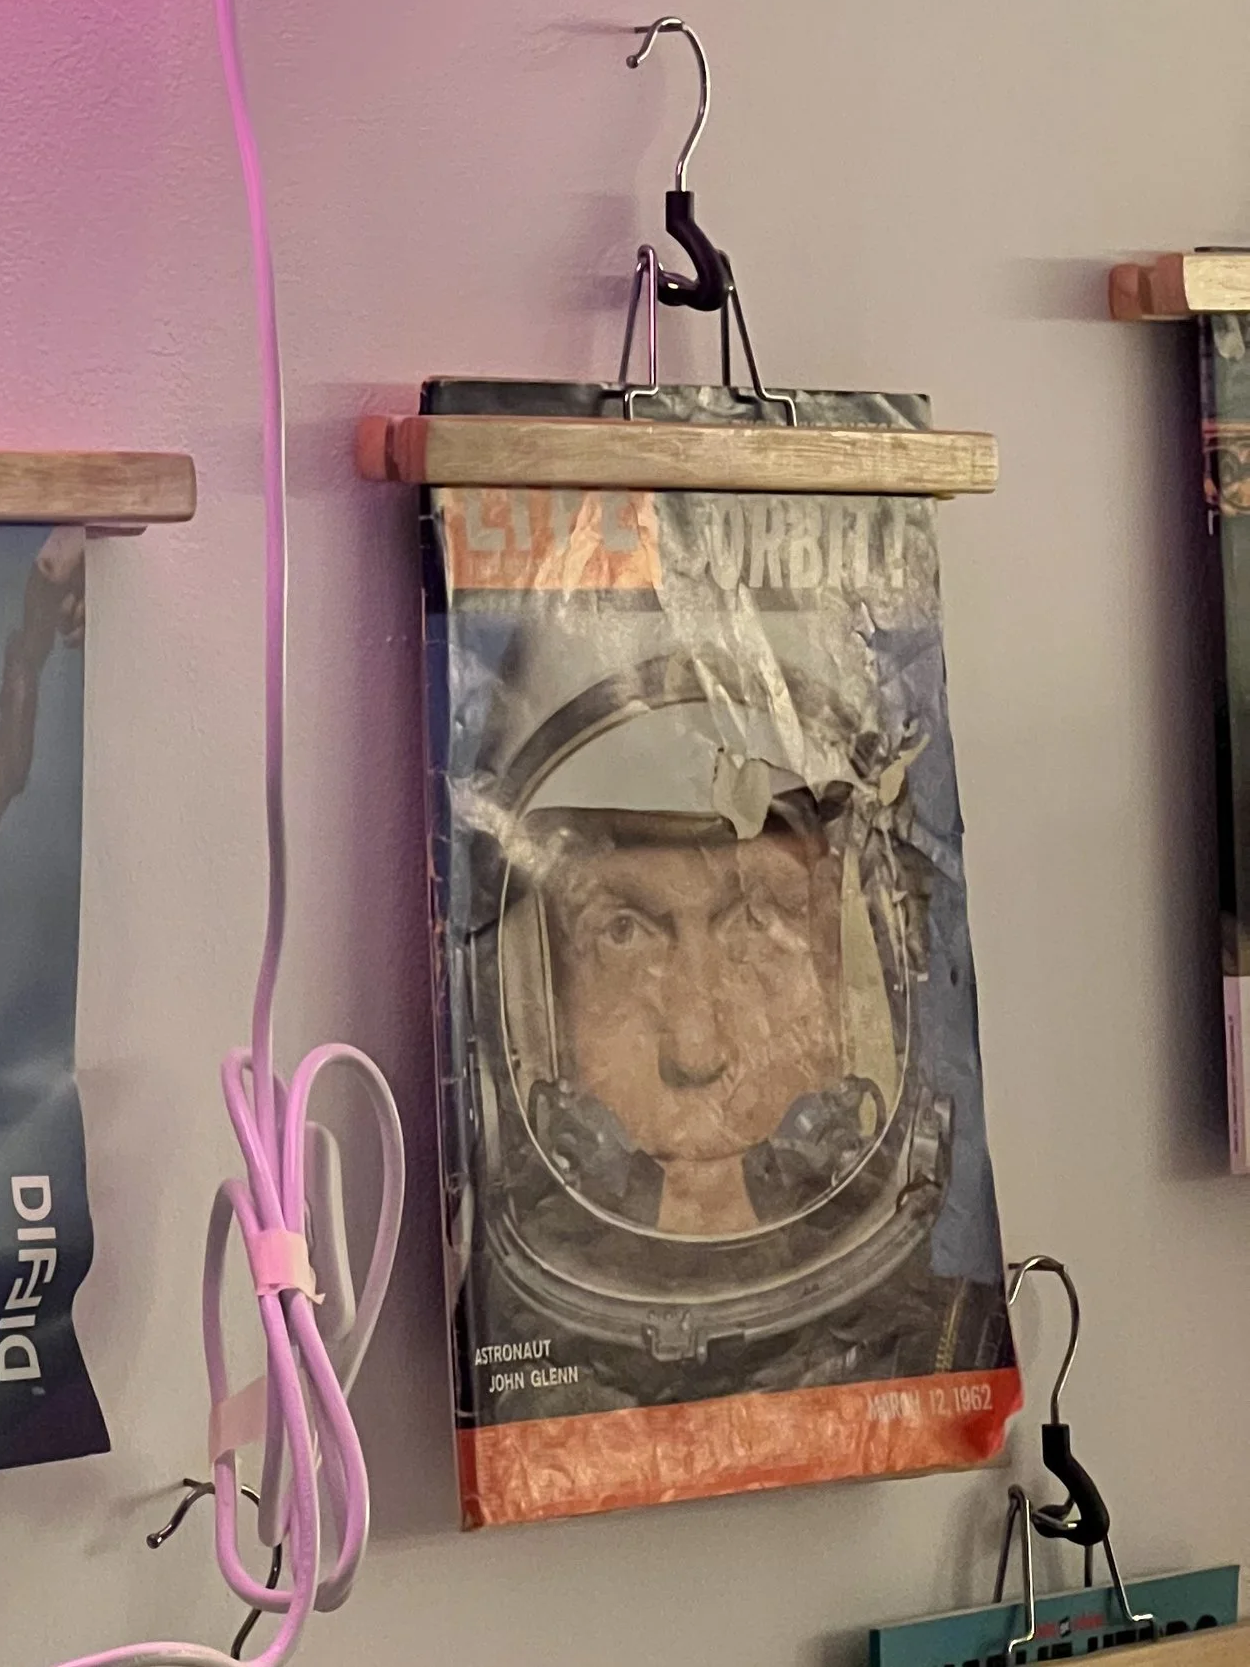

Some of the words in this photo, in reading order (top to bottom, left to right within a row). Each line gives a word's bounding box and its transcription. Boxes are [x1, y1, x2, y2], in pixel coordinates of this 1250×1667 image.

[475, 1339, 552, 1366] ASTRONAUT
[489, 1371, 525, 1393] JOHN
[530, 1366, 579, 1388] GLENN
[953, 1383, 993, 1413] 1962
